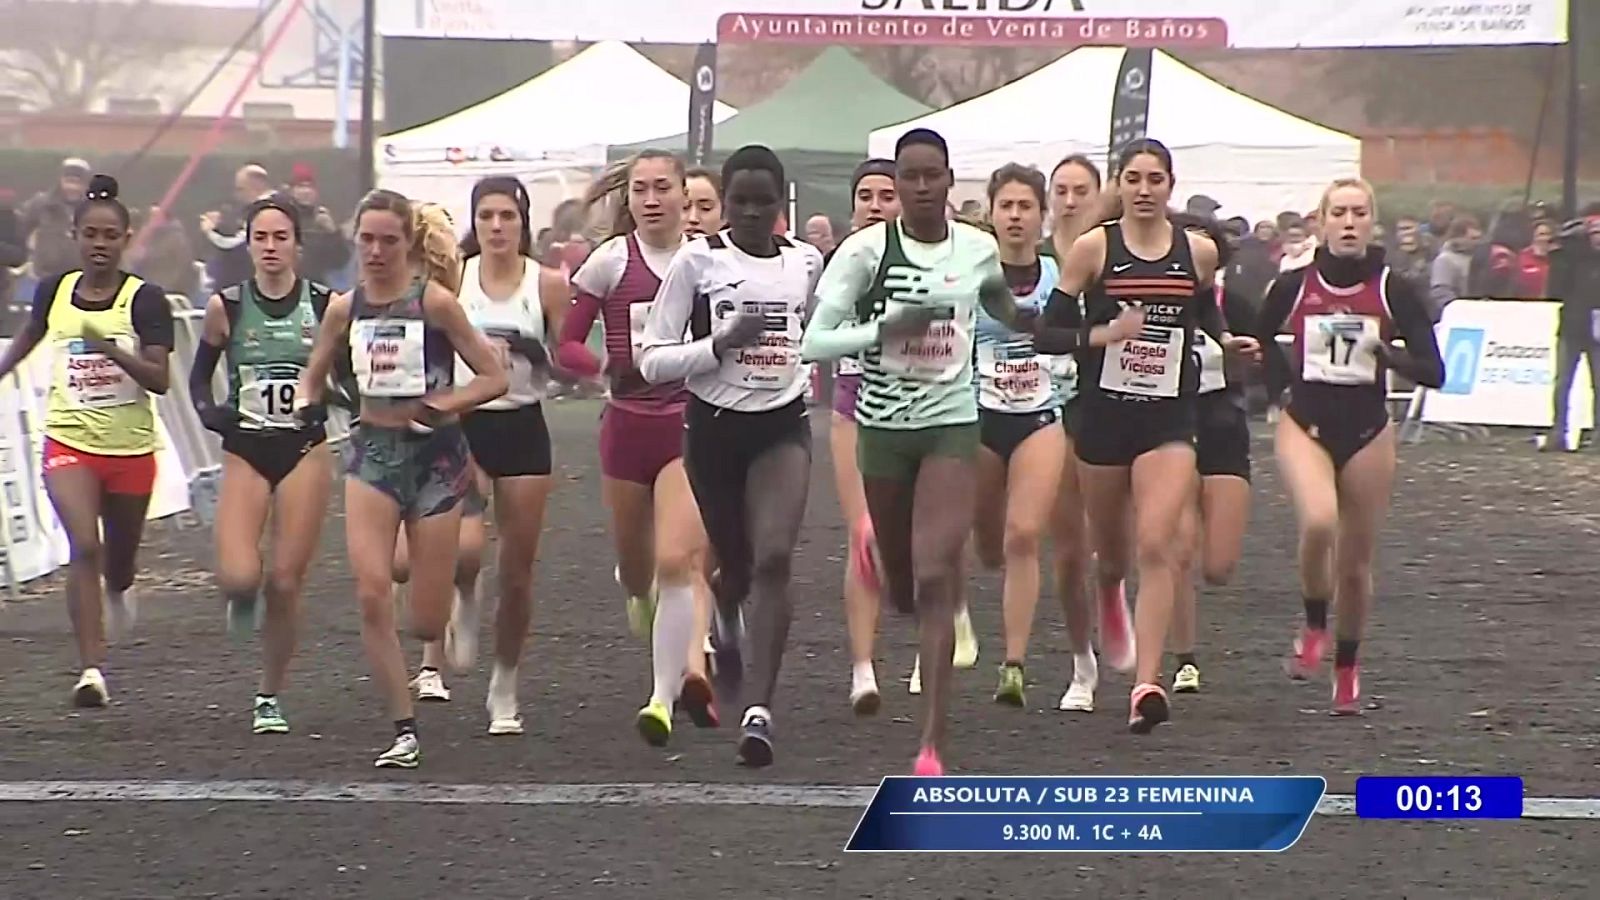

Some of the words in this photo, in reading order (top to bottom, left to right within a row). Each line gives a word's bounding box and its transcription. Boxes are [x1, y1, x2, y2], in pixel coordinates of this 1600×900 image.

[731, 14, 927, 39] Ayuntamiento
[943, 17, 973, 37] de
[986, 18, 1063, 38] Venta
[1079, 18, 1111, 38] de
[1126, 18, 1208, 38] Baños
[1324, 334, 1358, 365] 17
[994, 360, 1039, 373] Claudia
[1120, 357, 1165, 376] Viciosa
[261, 383, 296, 415] 19
